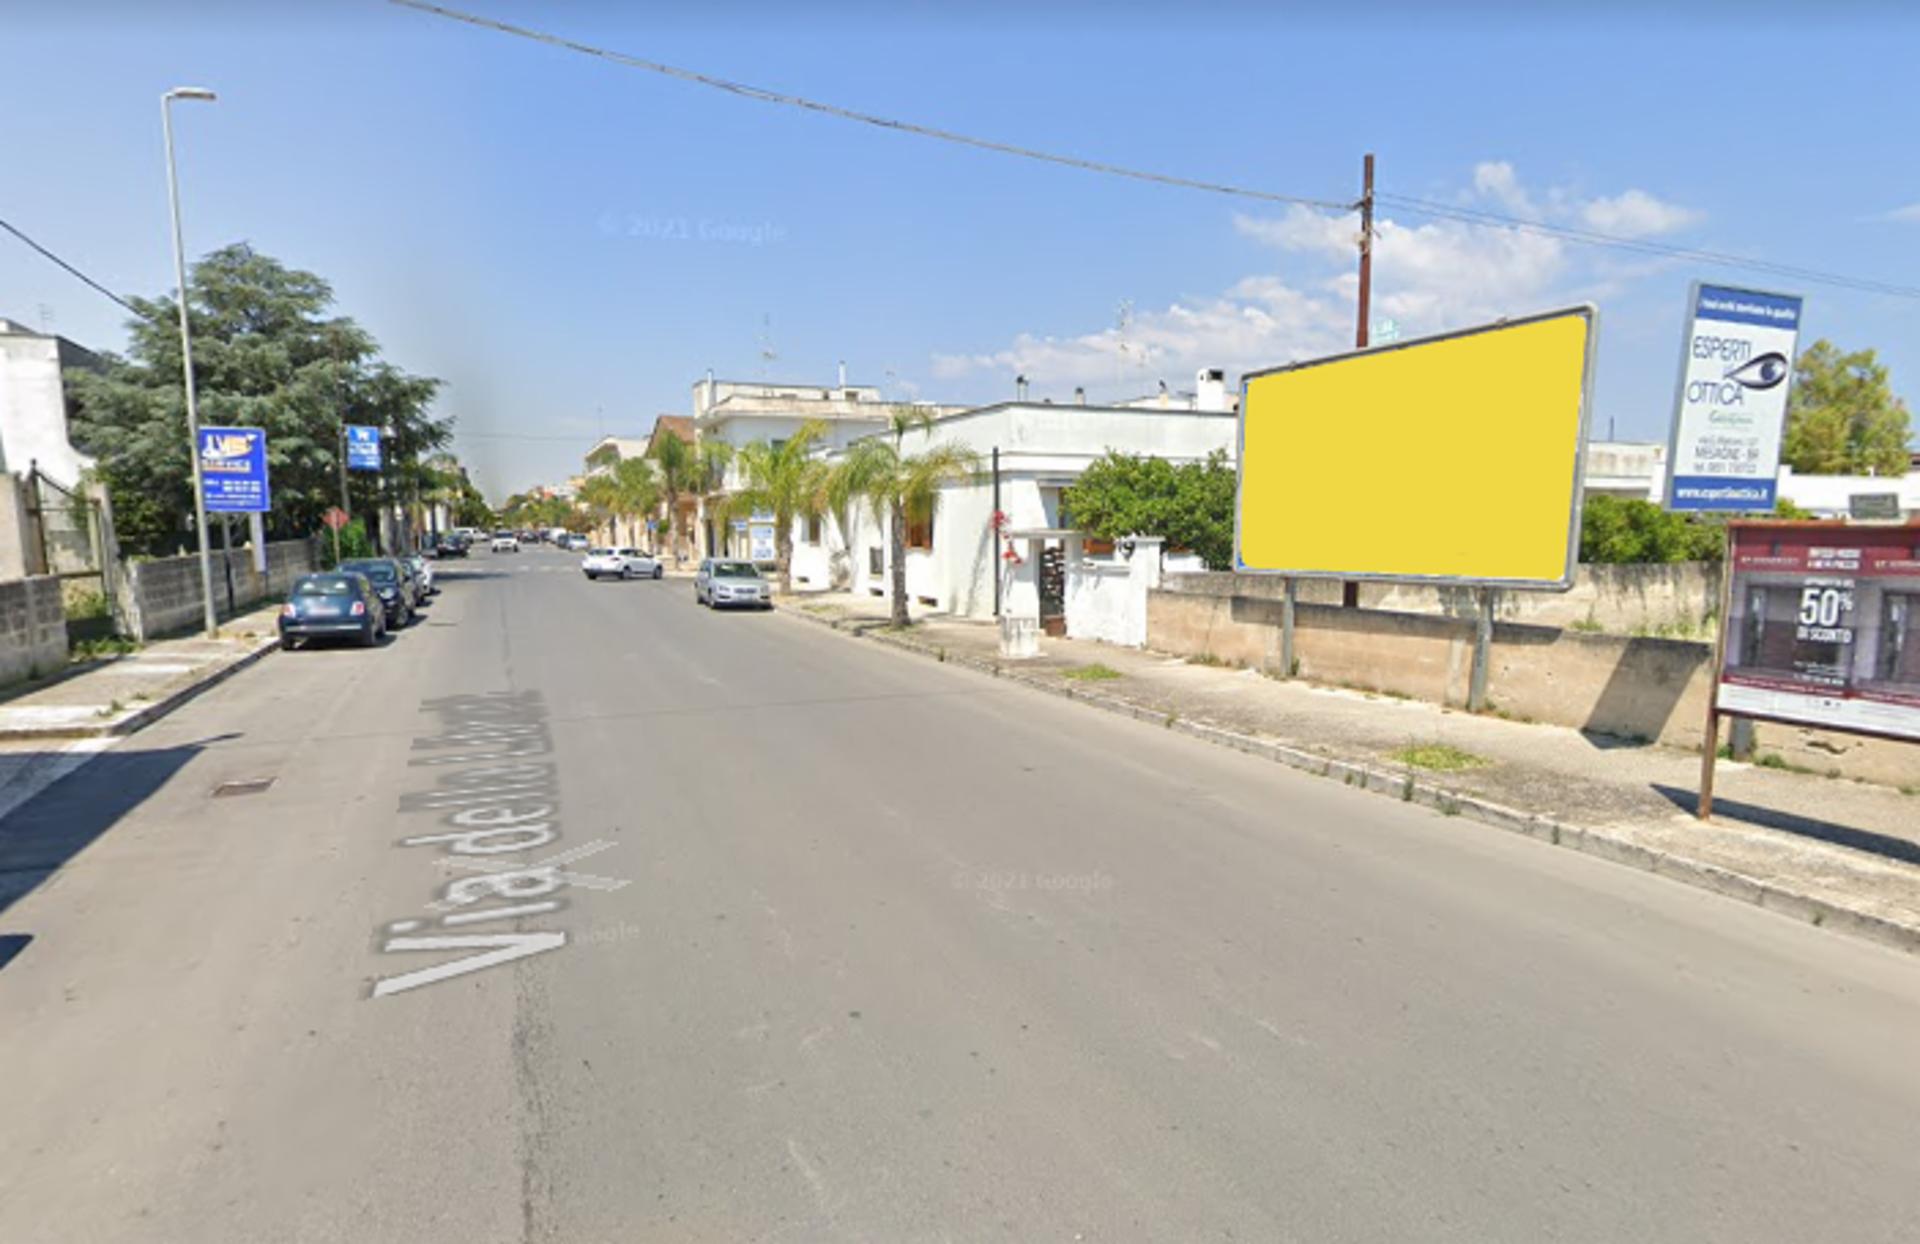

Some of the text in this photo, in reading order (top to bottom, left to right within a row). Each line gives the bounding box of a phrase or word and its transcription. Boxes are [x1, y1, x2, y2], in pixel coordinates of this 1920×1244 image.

[1692, 335, 1752, 361] ESPERTI
[1687, 380, 1745, 406] OTTICA
[1809, 628, 1853, 644] SCONTO
